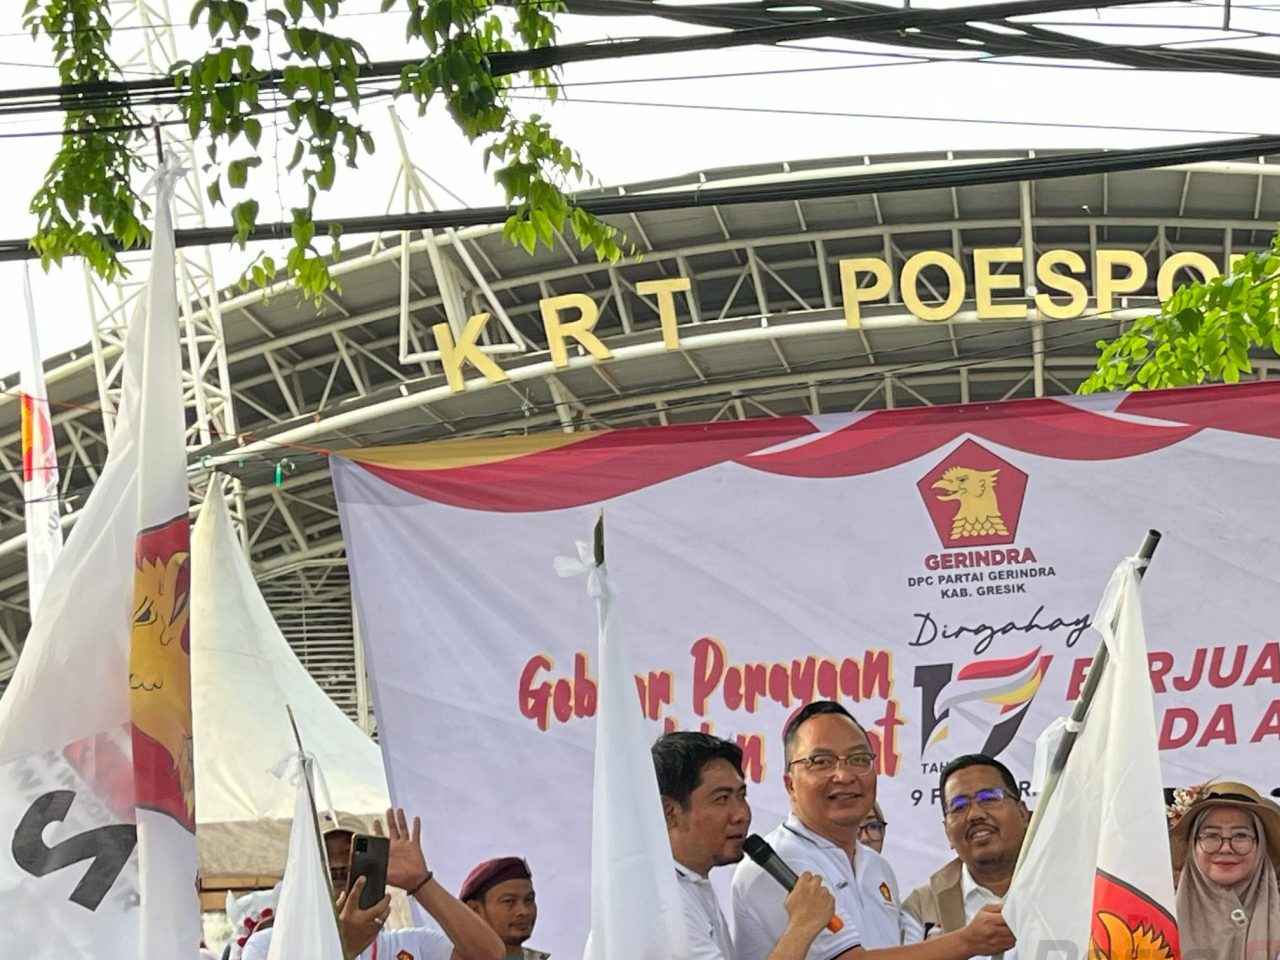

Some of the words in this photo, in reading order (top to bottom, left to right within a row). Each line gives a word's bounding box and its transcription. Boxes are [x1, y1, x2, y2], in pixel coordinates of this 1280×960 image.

[924, 548, 1037, 570] GERINDRA
[908, 576, 934, 588] DPC
[938, 572, 984, 585] PARTAI
[988, 566, 1056, 581] GERINDRA
[941, 588, 972, 599] KAB.
[976, 584, 1026, 596] GRESIK
[908, 605, 1092, 655] Dirgahay
[921, 762, 949, 774] TAH
